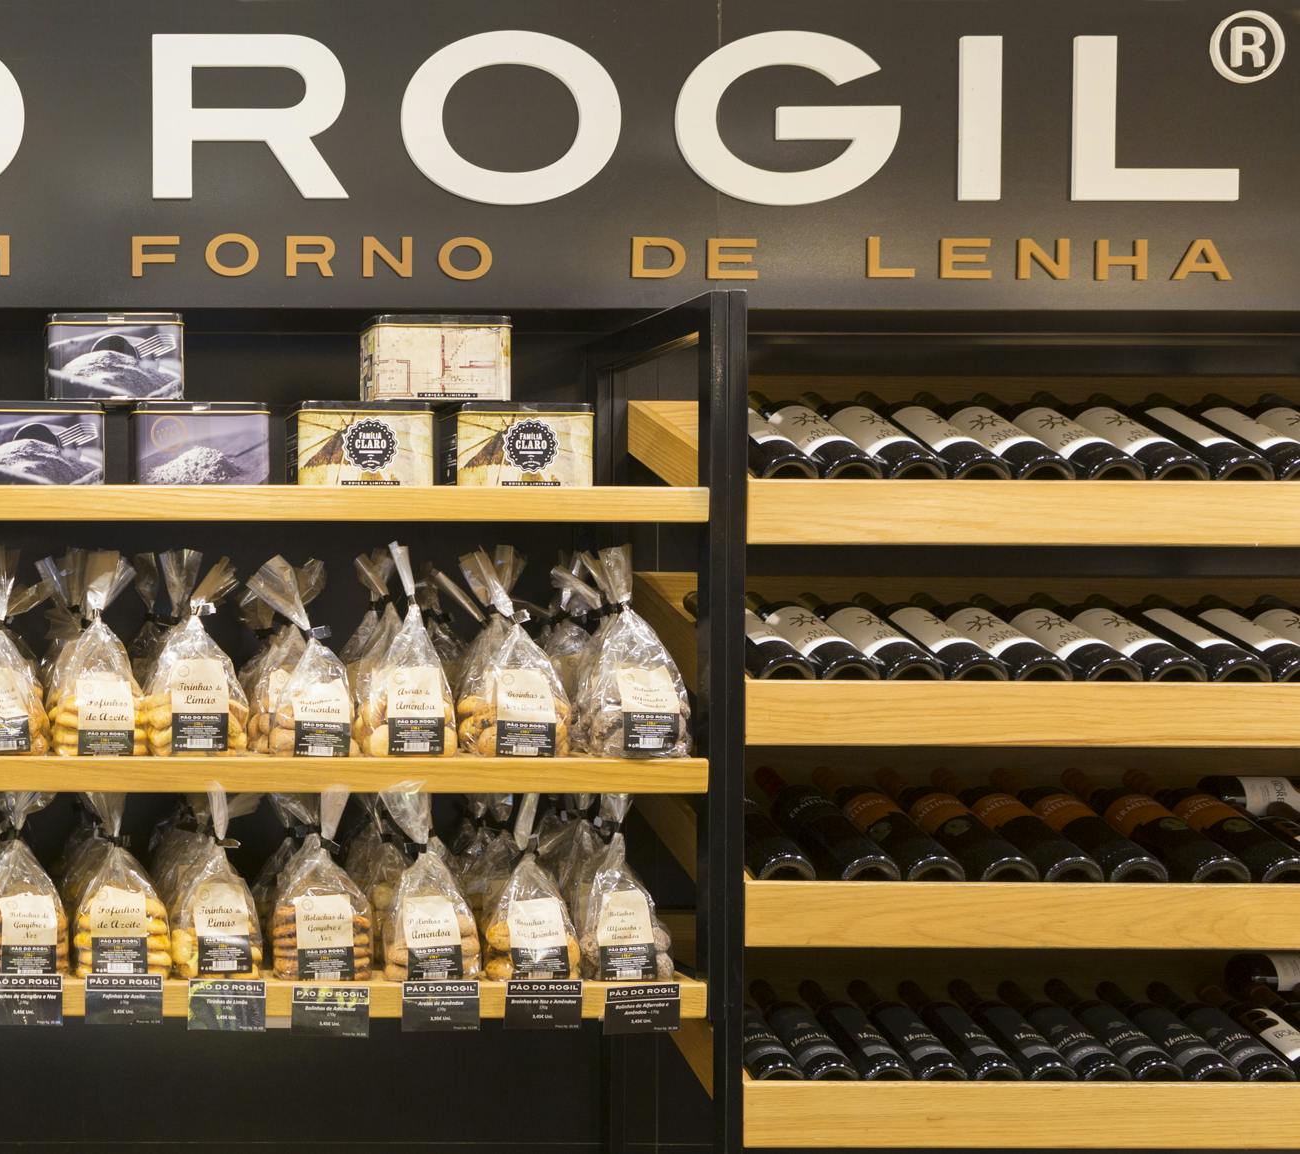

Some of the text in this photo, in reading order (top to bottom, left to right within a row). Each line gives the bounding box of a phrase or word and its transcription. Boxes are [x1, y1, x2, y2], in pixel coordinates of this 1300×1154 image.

[152, 31, 1240, 205] ROGIL
[131, 233, 495, 281] FORNO
[631, 236, 761, 281] DE
[866, 236, 1235, 283] LENHA
[355, 439, 388, 450] CLARO
[515, 439, 548, 450] CLARO
[89, 977, 110, 985] PÃO
[193, 982, 213, 990] PÃO
[406, 984, 426, 992] PÃO
[510, 983, 530, 991] PÃO
[609, 989, 630, 997] PÃO
[647, 987, 676, 995] ROGIL
